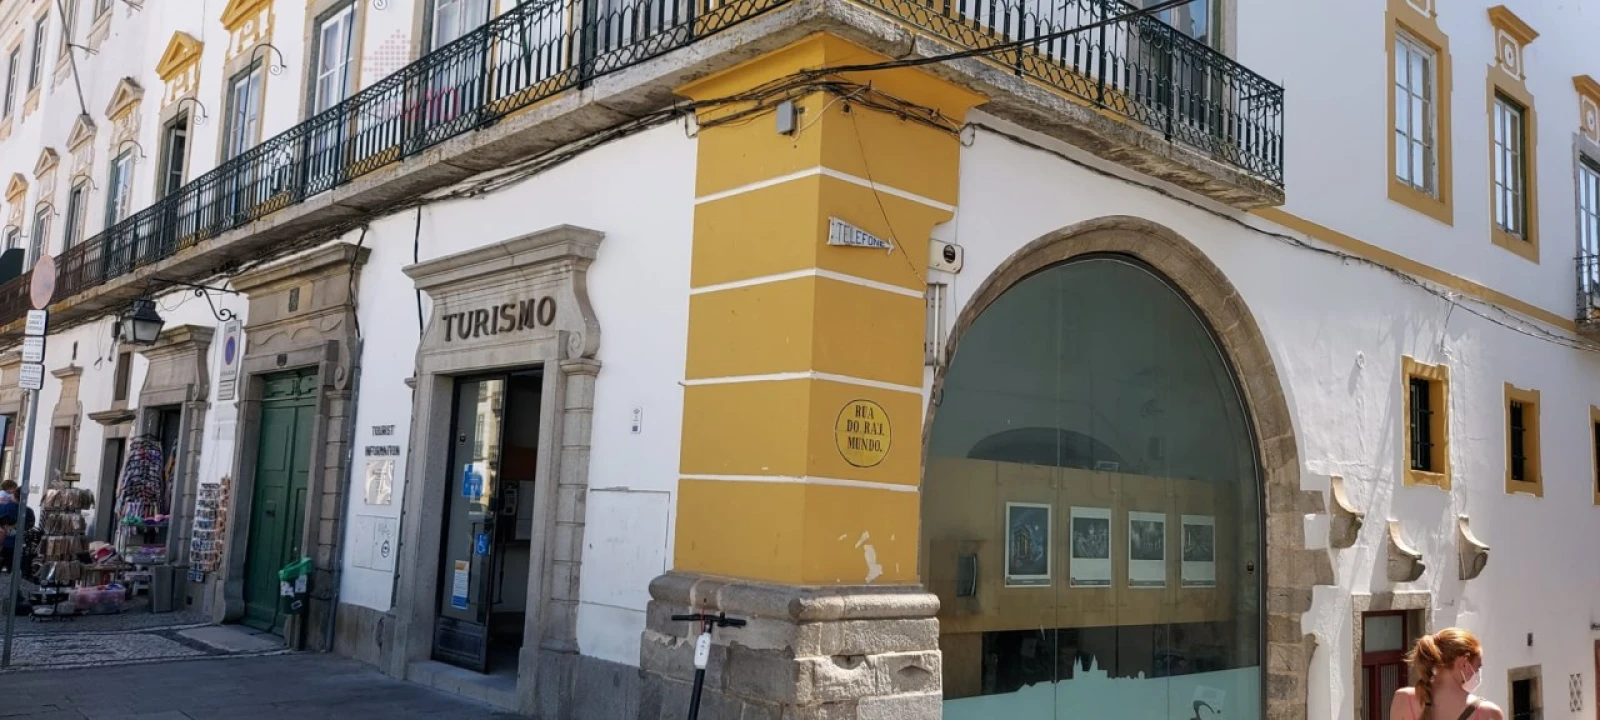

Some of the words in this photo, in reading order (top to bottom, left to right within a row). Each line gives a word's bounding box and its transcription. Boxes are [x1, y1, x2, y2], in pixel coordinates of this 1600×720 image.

[837, 222, 884, 247] TELEFONE
[442, 296, 557, 342] TURISMO
[855, 404, 874, 420] RUA
[371, 424, 396, 436] TOURIST
[847, 419, 860, 433] DO
[364, 444, 401, 457] INFORMATION
